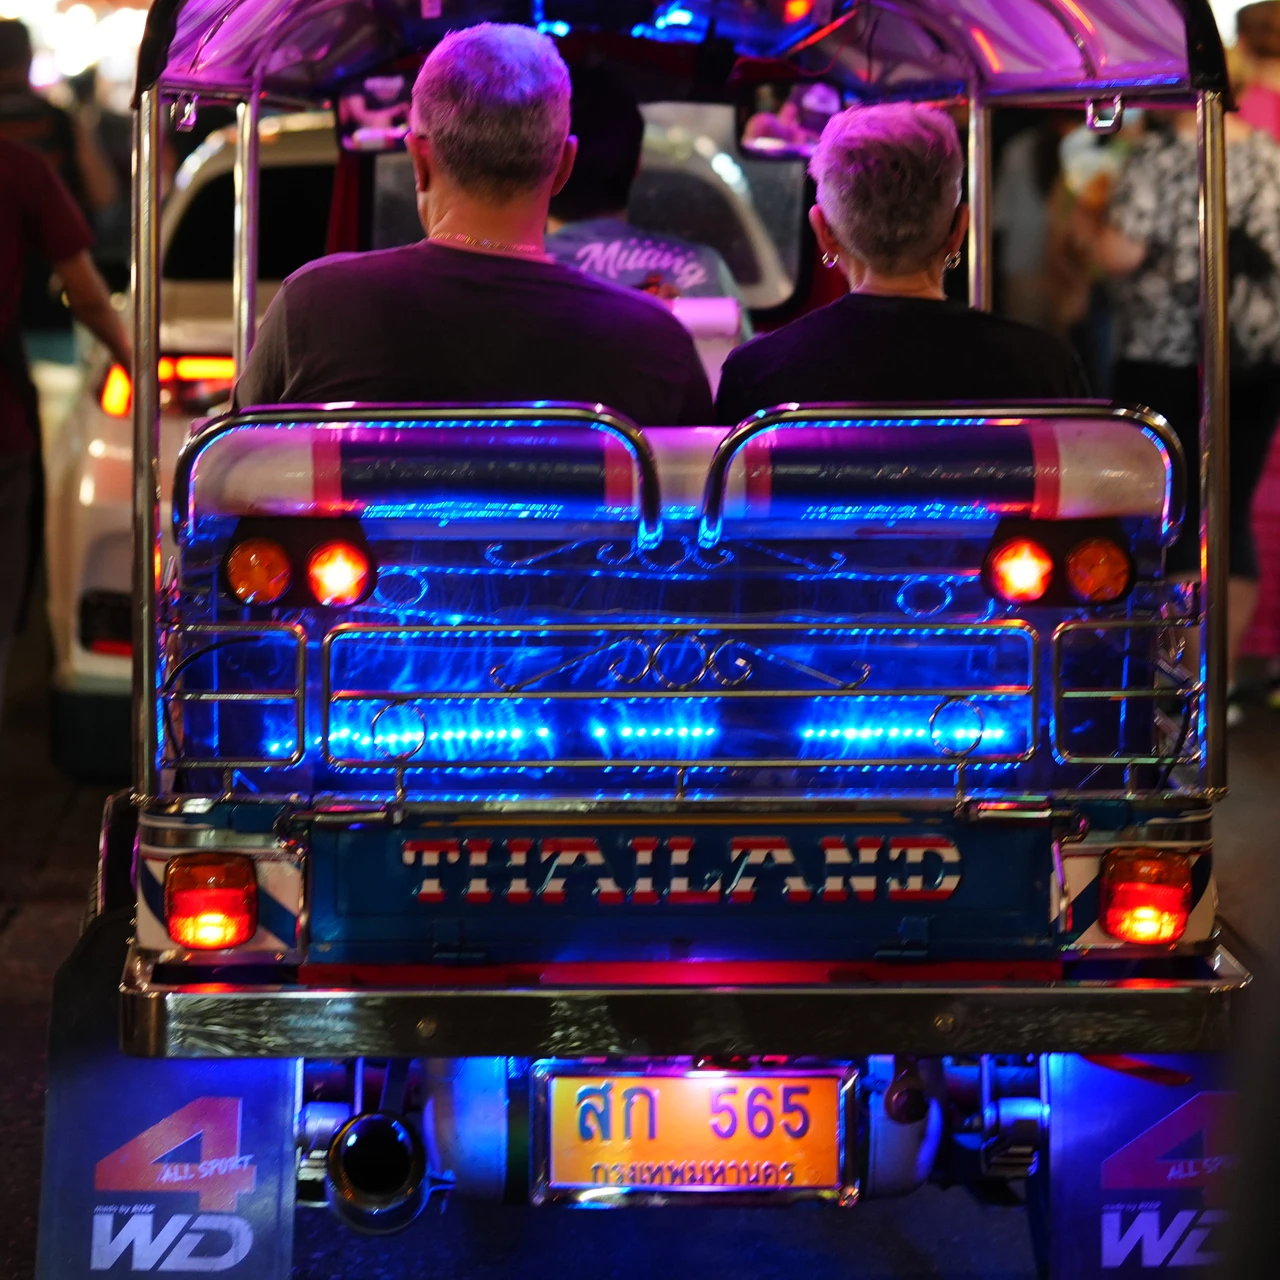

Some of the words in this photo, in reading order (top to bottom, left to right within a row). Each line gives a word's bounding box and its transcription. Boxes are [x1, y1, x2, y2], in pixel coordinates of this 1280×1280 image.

[402, 836, 962, 903] THAILAND
[575, 1080, 659, 1141] สก
[709, 1084, 812, 1139] 565
[94, 1096, 258, 1212] 4
[156, 1162, 196, 1183] ALL
[198, 1154, 255, 1179] SPORT
[90, 1214, 255, 1272] WD
